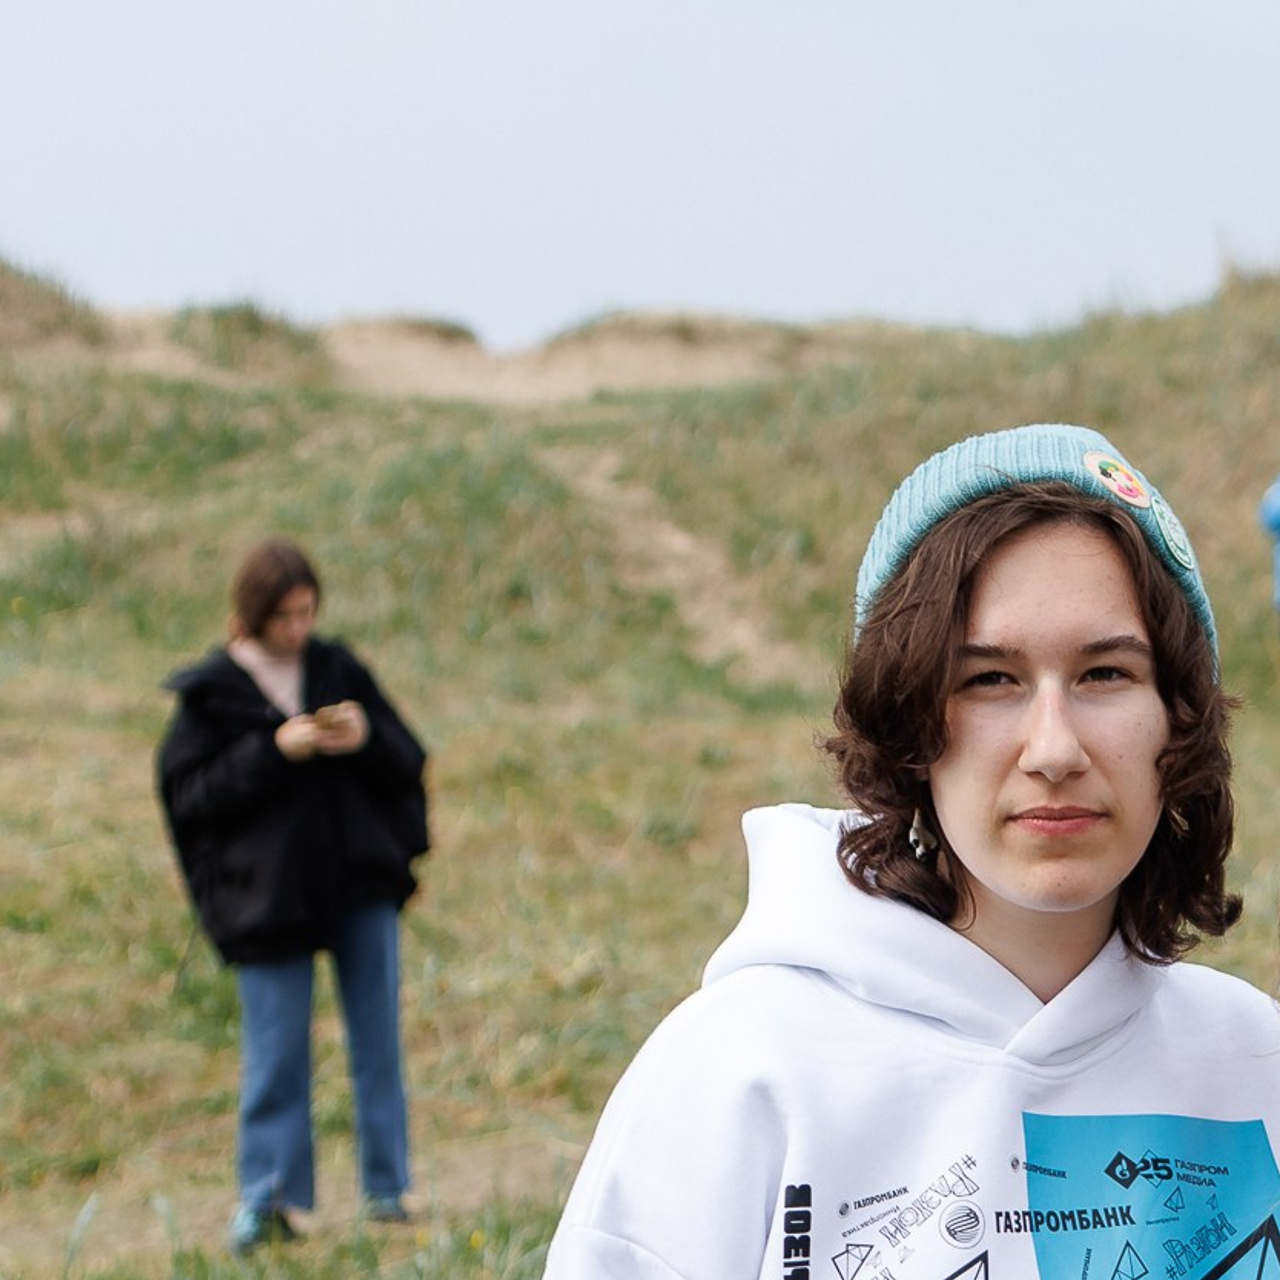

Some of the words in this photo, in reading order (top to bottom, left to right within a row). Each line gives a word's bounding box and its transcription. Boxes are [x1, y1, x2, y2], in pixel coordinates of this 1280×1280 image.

[1174, 1159, 1229, 1176] ГАЗПРОМ
[1176, 1172, 1216, 1187] МЕДИА
[853, 1186, 909, 1209] ГАЗПРОМБАНК
[995, 1205, 1136, 1233] ГАЗПРОМБАНК
